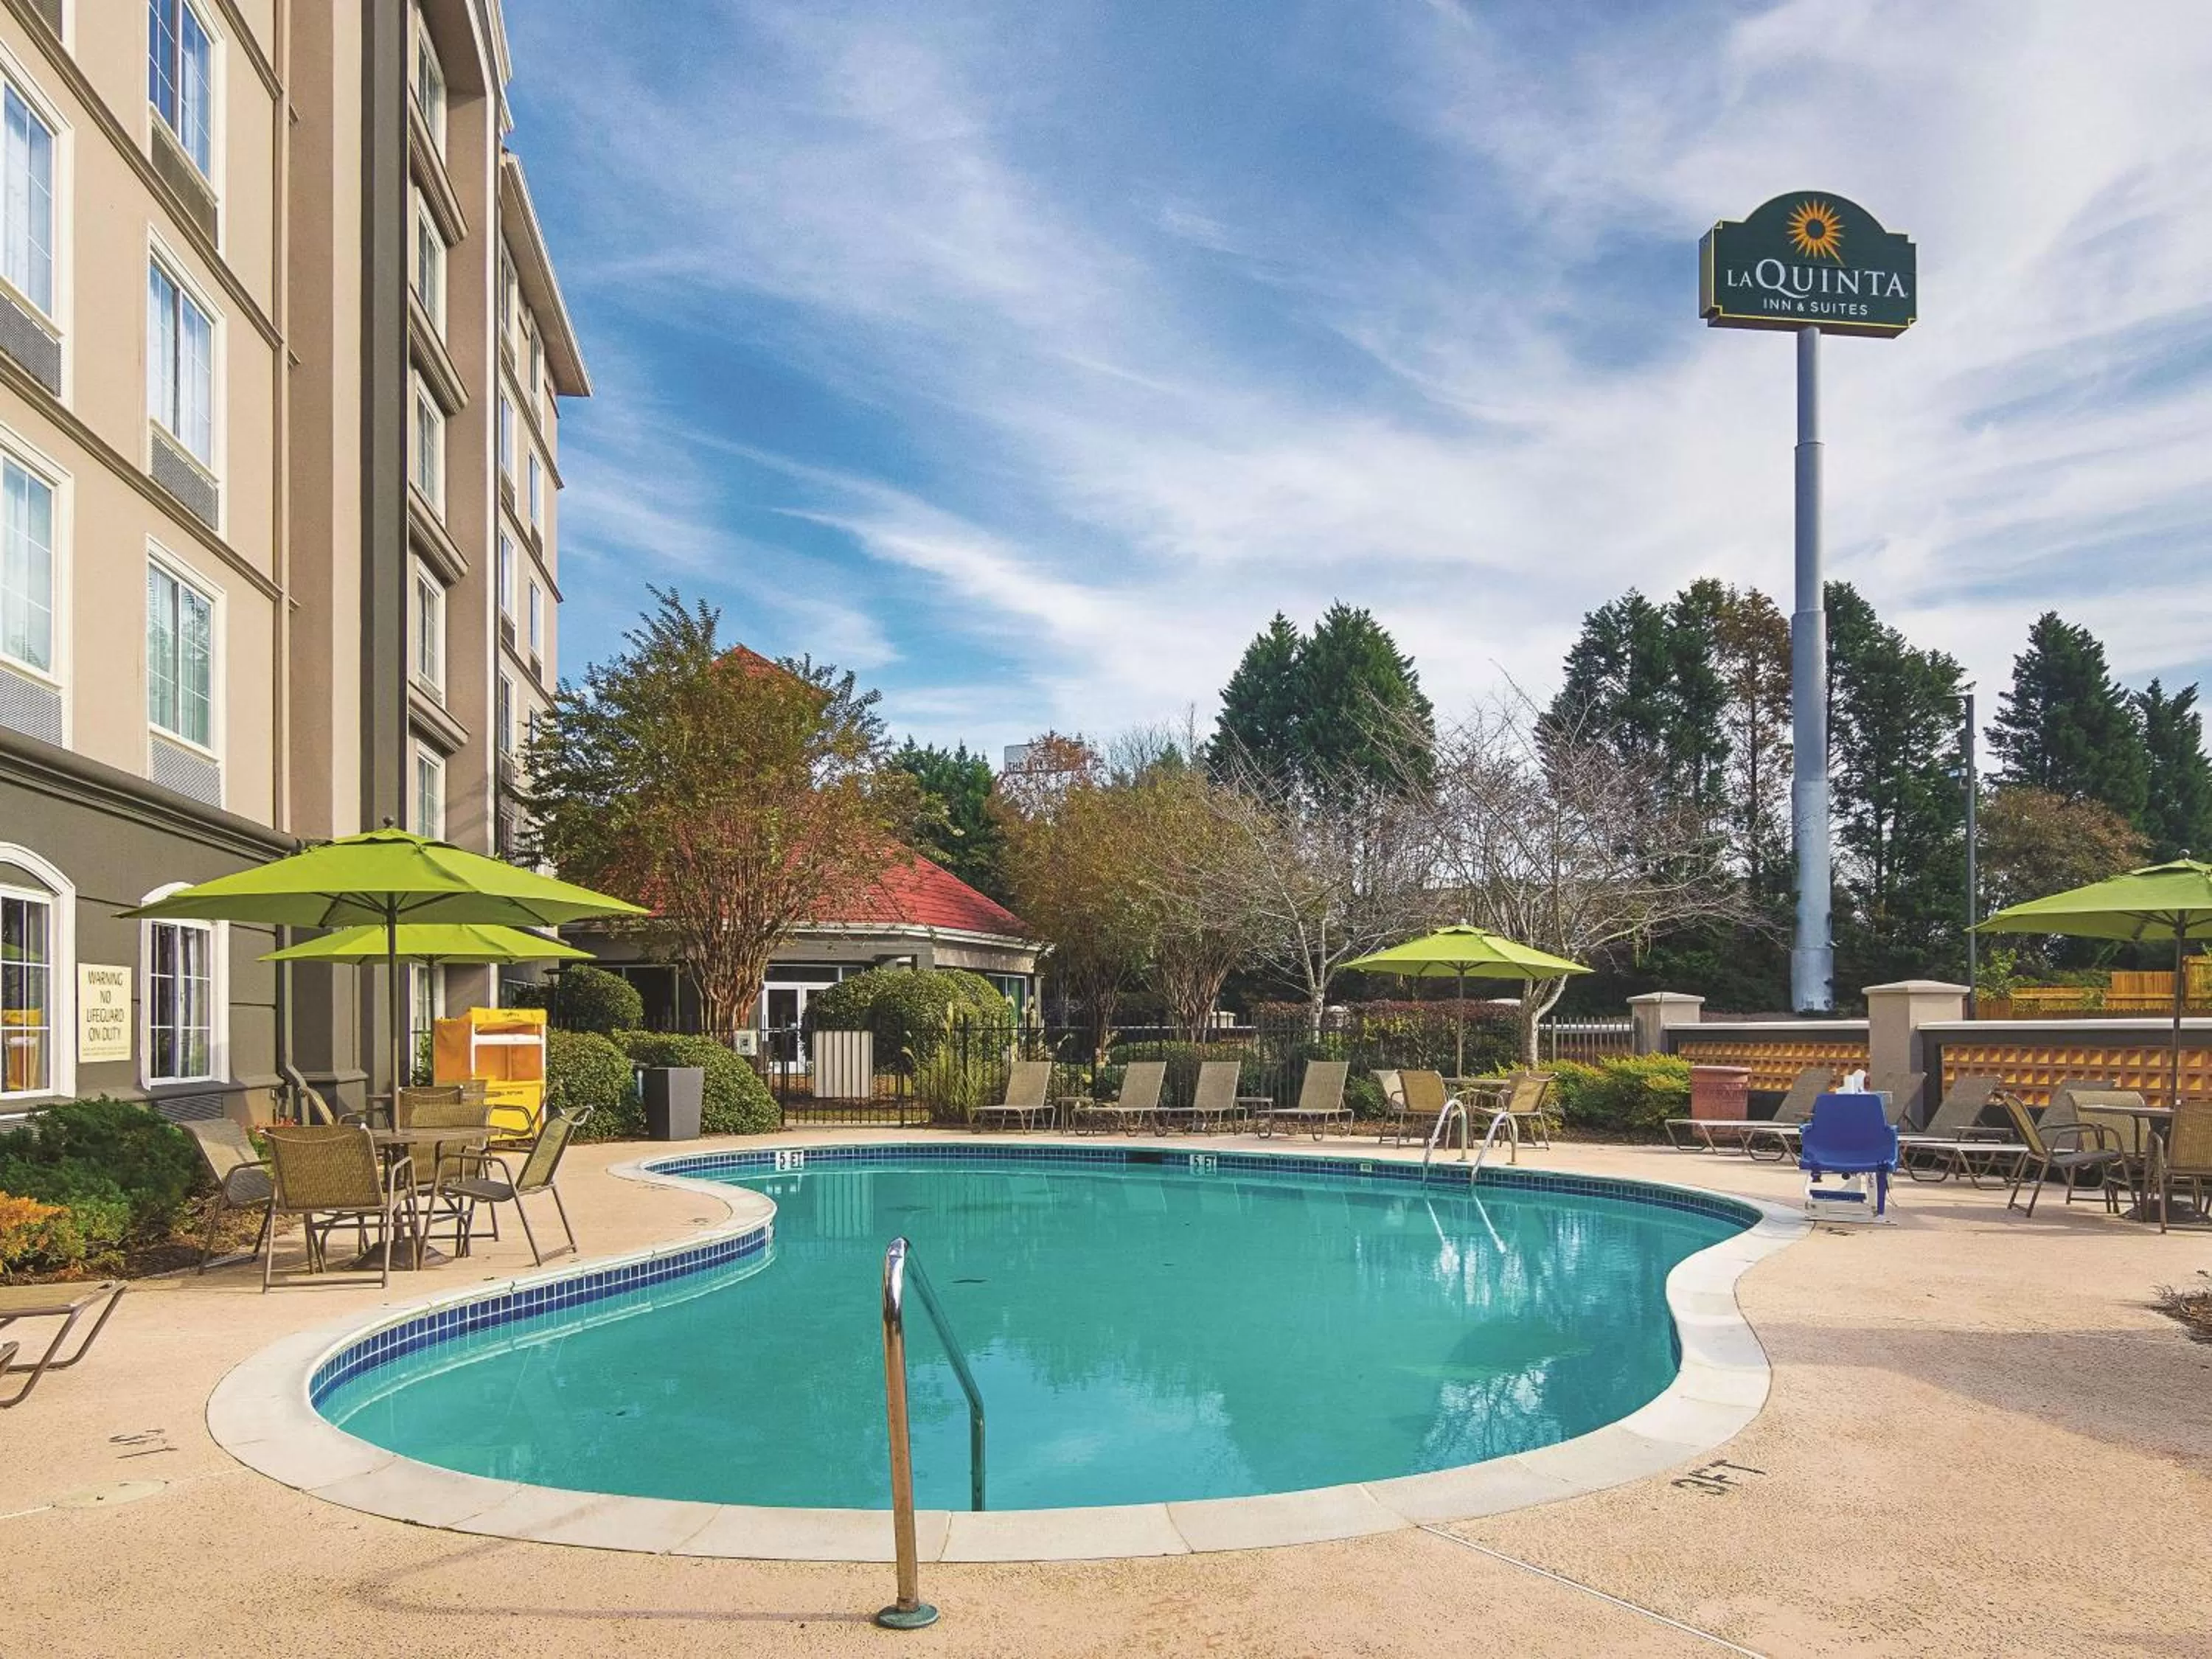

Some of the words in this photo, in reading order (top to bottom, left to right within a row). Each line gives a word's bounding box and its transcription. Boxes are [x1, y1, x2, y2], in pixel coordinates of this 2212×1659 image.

[1726, 269, 1753, 288] LA
[1755, 258, 1908, 299] QUINTA
[1763, 298, 1792, 311] INN
[1797, 303, 1806, 313] &
[1810, 301, 1868, 316] SUITES
[88, 970, 123, 986] WARNING
[100, 990, 111, 1004] NO
[86, 1008, 125, 1023] LIFEGUARD
[88, 1027, 101, 1042] ON
[102, 1027, 122, 1041] DUTY
